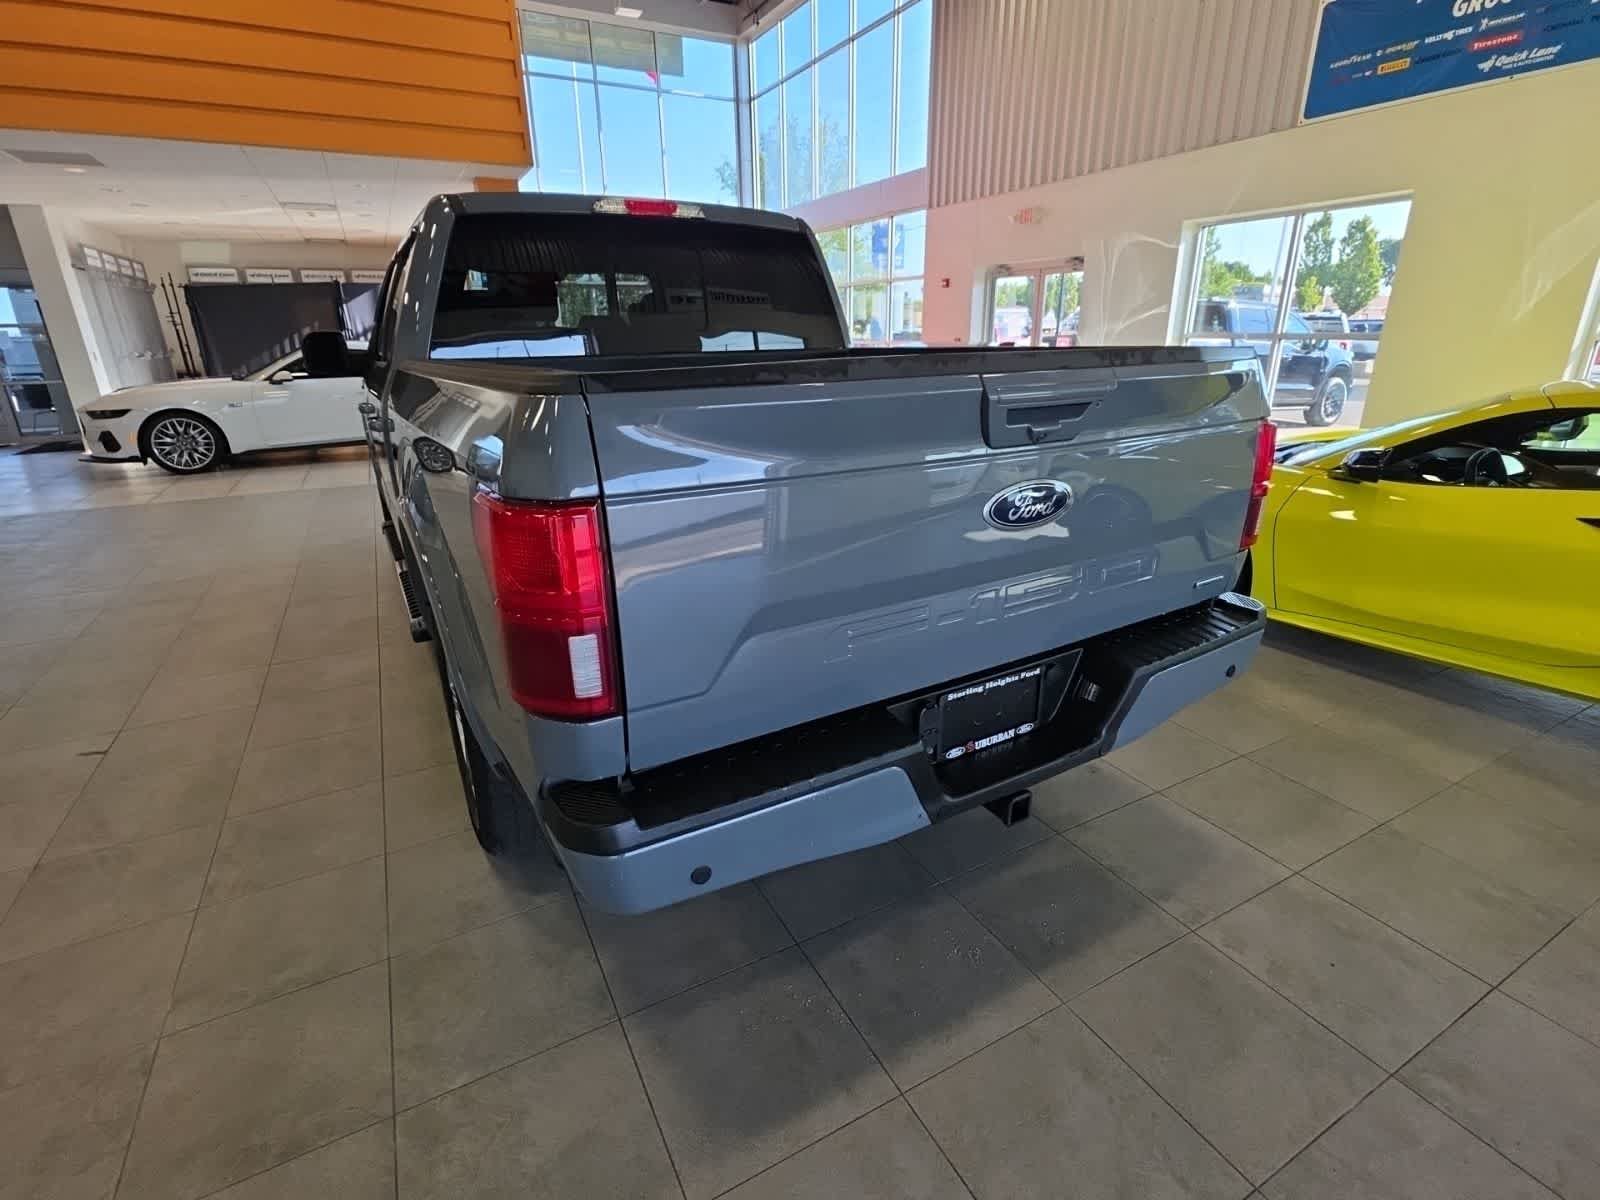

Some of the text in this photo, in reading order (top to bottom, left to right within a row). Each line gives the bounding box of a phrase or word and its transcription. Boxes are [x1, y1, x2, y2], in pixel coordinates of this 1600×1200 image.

[1495, 44, 1561, 67] Quick Lane
[1008, 490, 1055, 521] Ford
[947, 668, 1041, 701] Sterling Heights Ford
[966, 728, 1015, 753] SUBURBAN
